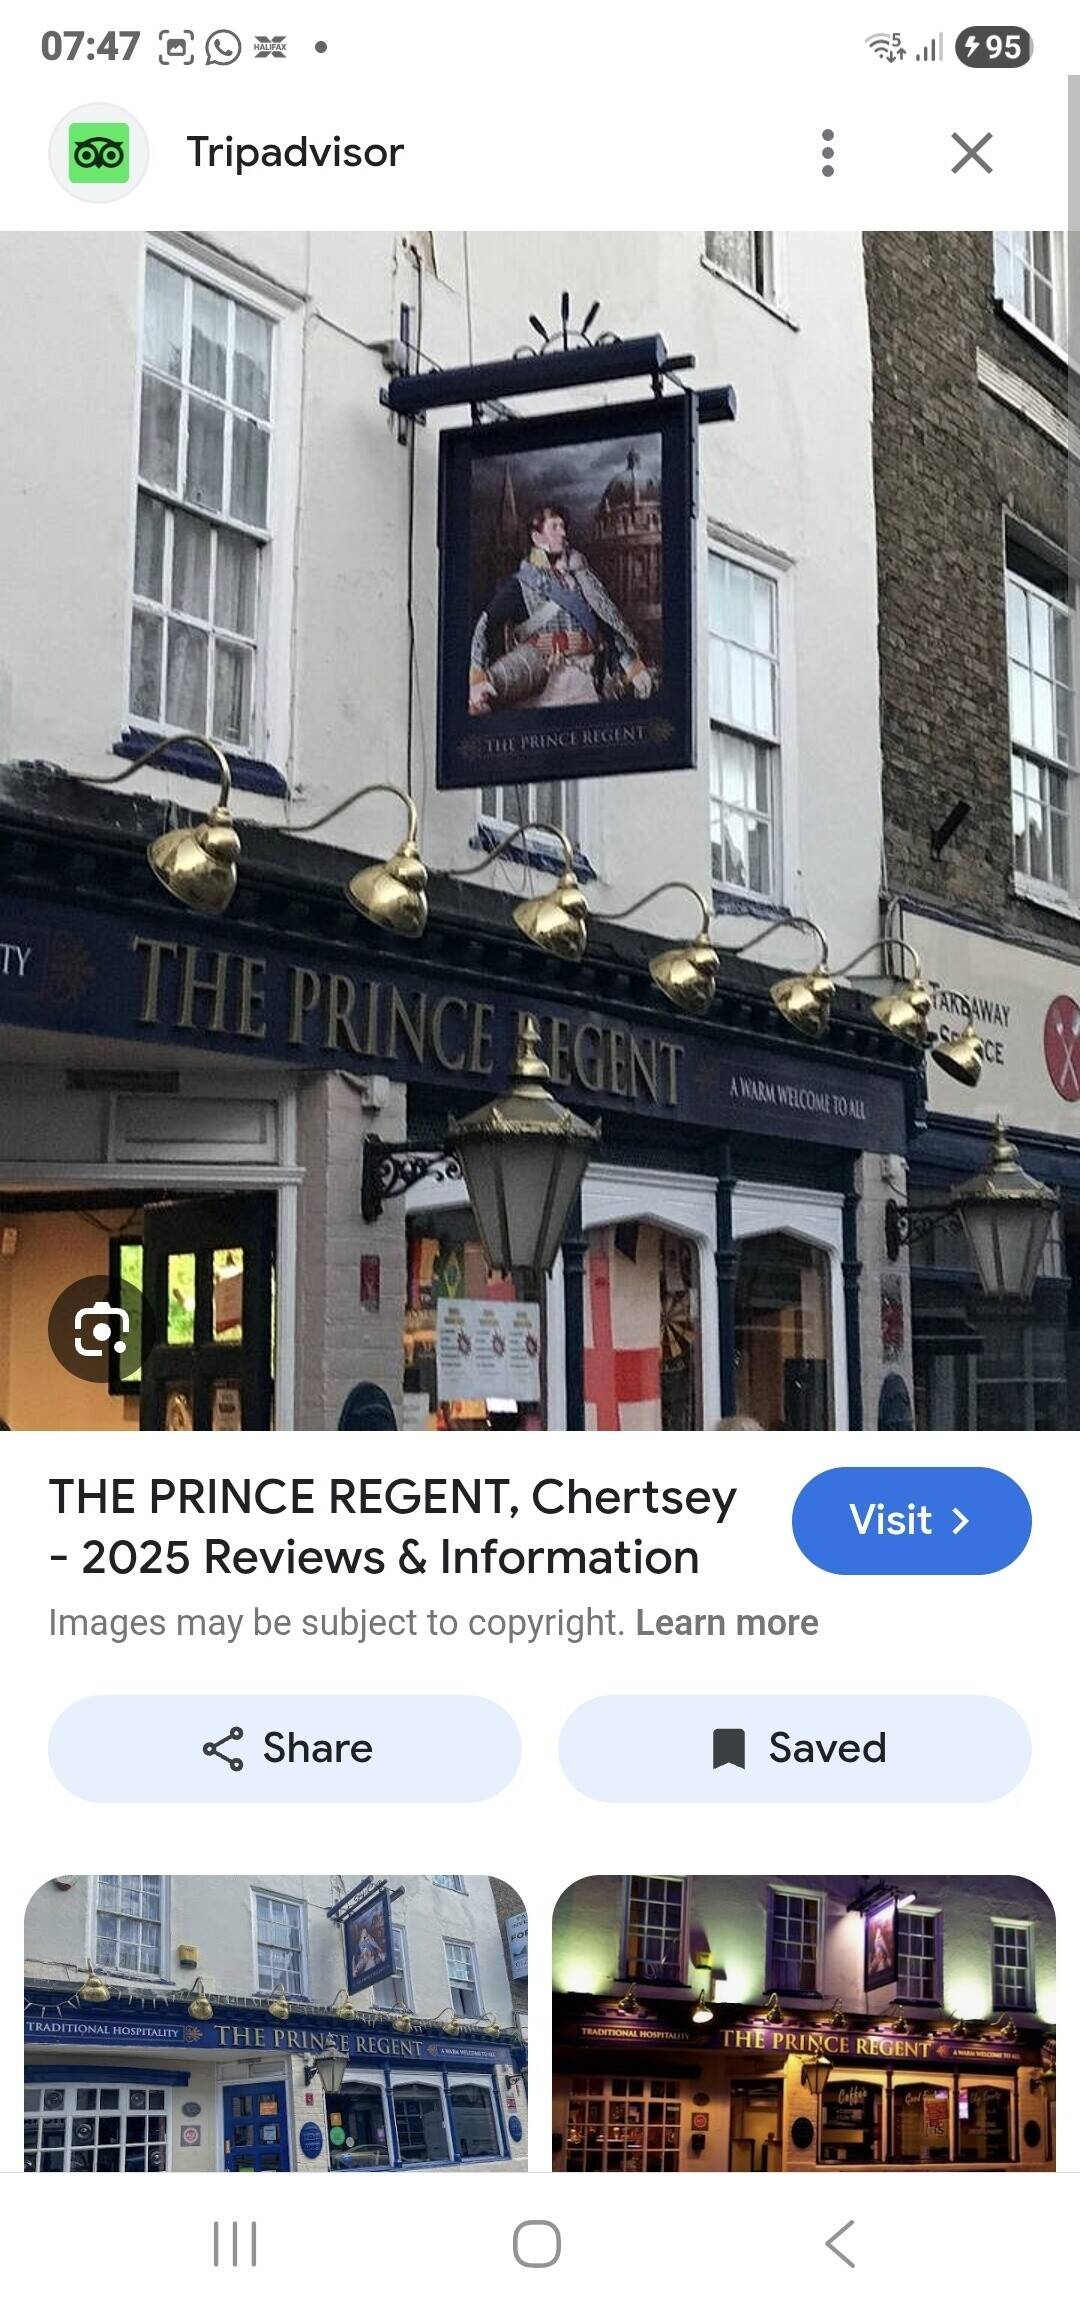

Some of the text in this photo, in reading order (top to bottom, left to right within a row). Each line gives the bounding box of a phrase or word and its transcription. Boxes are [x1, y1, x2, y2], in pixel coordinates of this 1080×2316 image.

[42, 31, 141, 61] 07:47
[253, 43, 287, 51] HALIFAX
[892, 32, 902, 48] 5
[985, 34, 1021, 60] 95
[187, 135, 405, 175] Tripadvisor
[486, 725, 646, 753] THE PRINCE REGENT
[133, 936, 267, 1038] THE
[288, 965, 495, 1075] PRINCE
[729, 1076, 866, 1120] A WARM WELCOME TO ALL
[49, 1478, 738, 1523] THE PRINCE REGENT, Chertsey
[849, 1503, 933, 1536] Visit
[83, 1539, 190, 1575] 2025
[206, 1538, 386, 1575] Reviews
[399, 1538, 427, 1575] &
[443, 1538, 699, 1575] Information
[51, 1607, 819, 1644] Images may be subject to copyright. Learn more
[264, 1731, 373, 1764] Share
[770, 1731, 886, 1764] Saved
[26, 2021, 179, 2038] TRADITIONAL HOSPITALITY
[214, 2025, 265, 2047] THE
[356, 2035, 423, 2057] REGENT
[582, 2027, 690, 2040] TRADITIONAL HOSPITALITY
[720, 2030, 931, 2058] THE PRINCE REGENT
